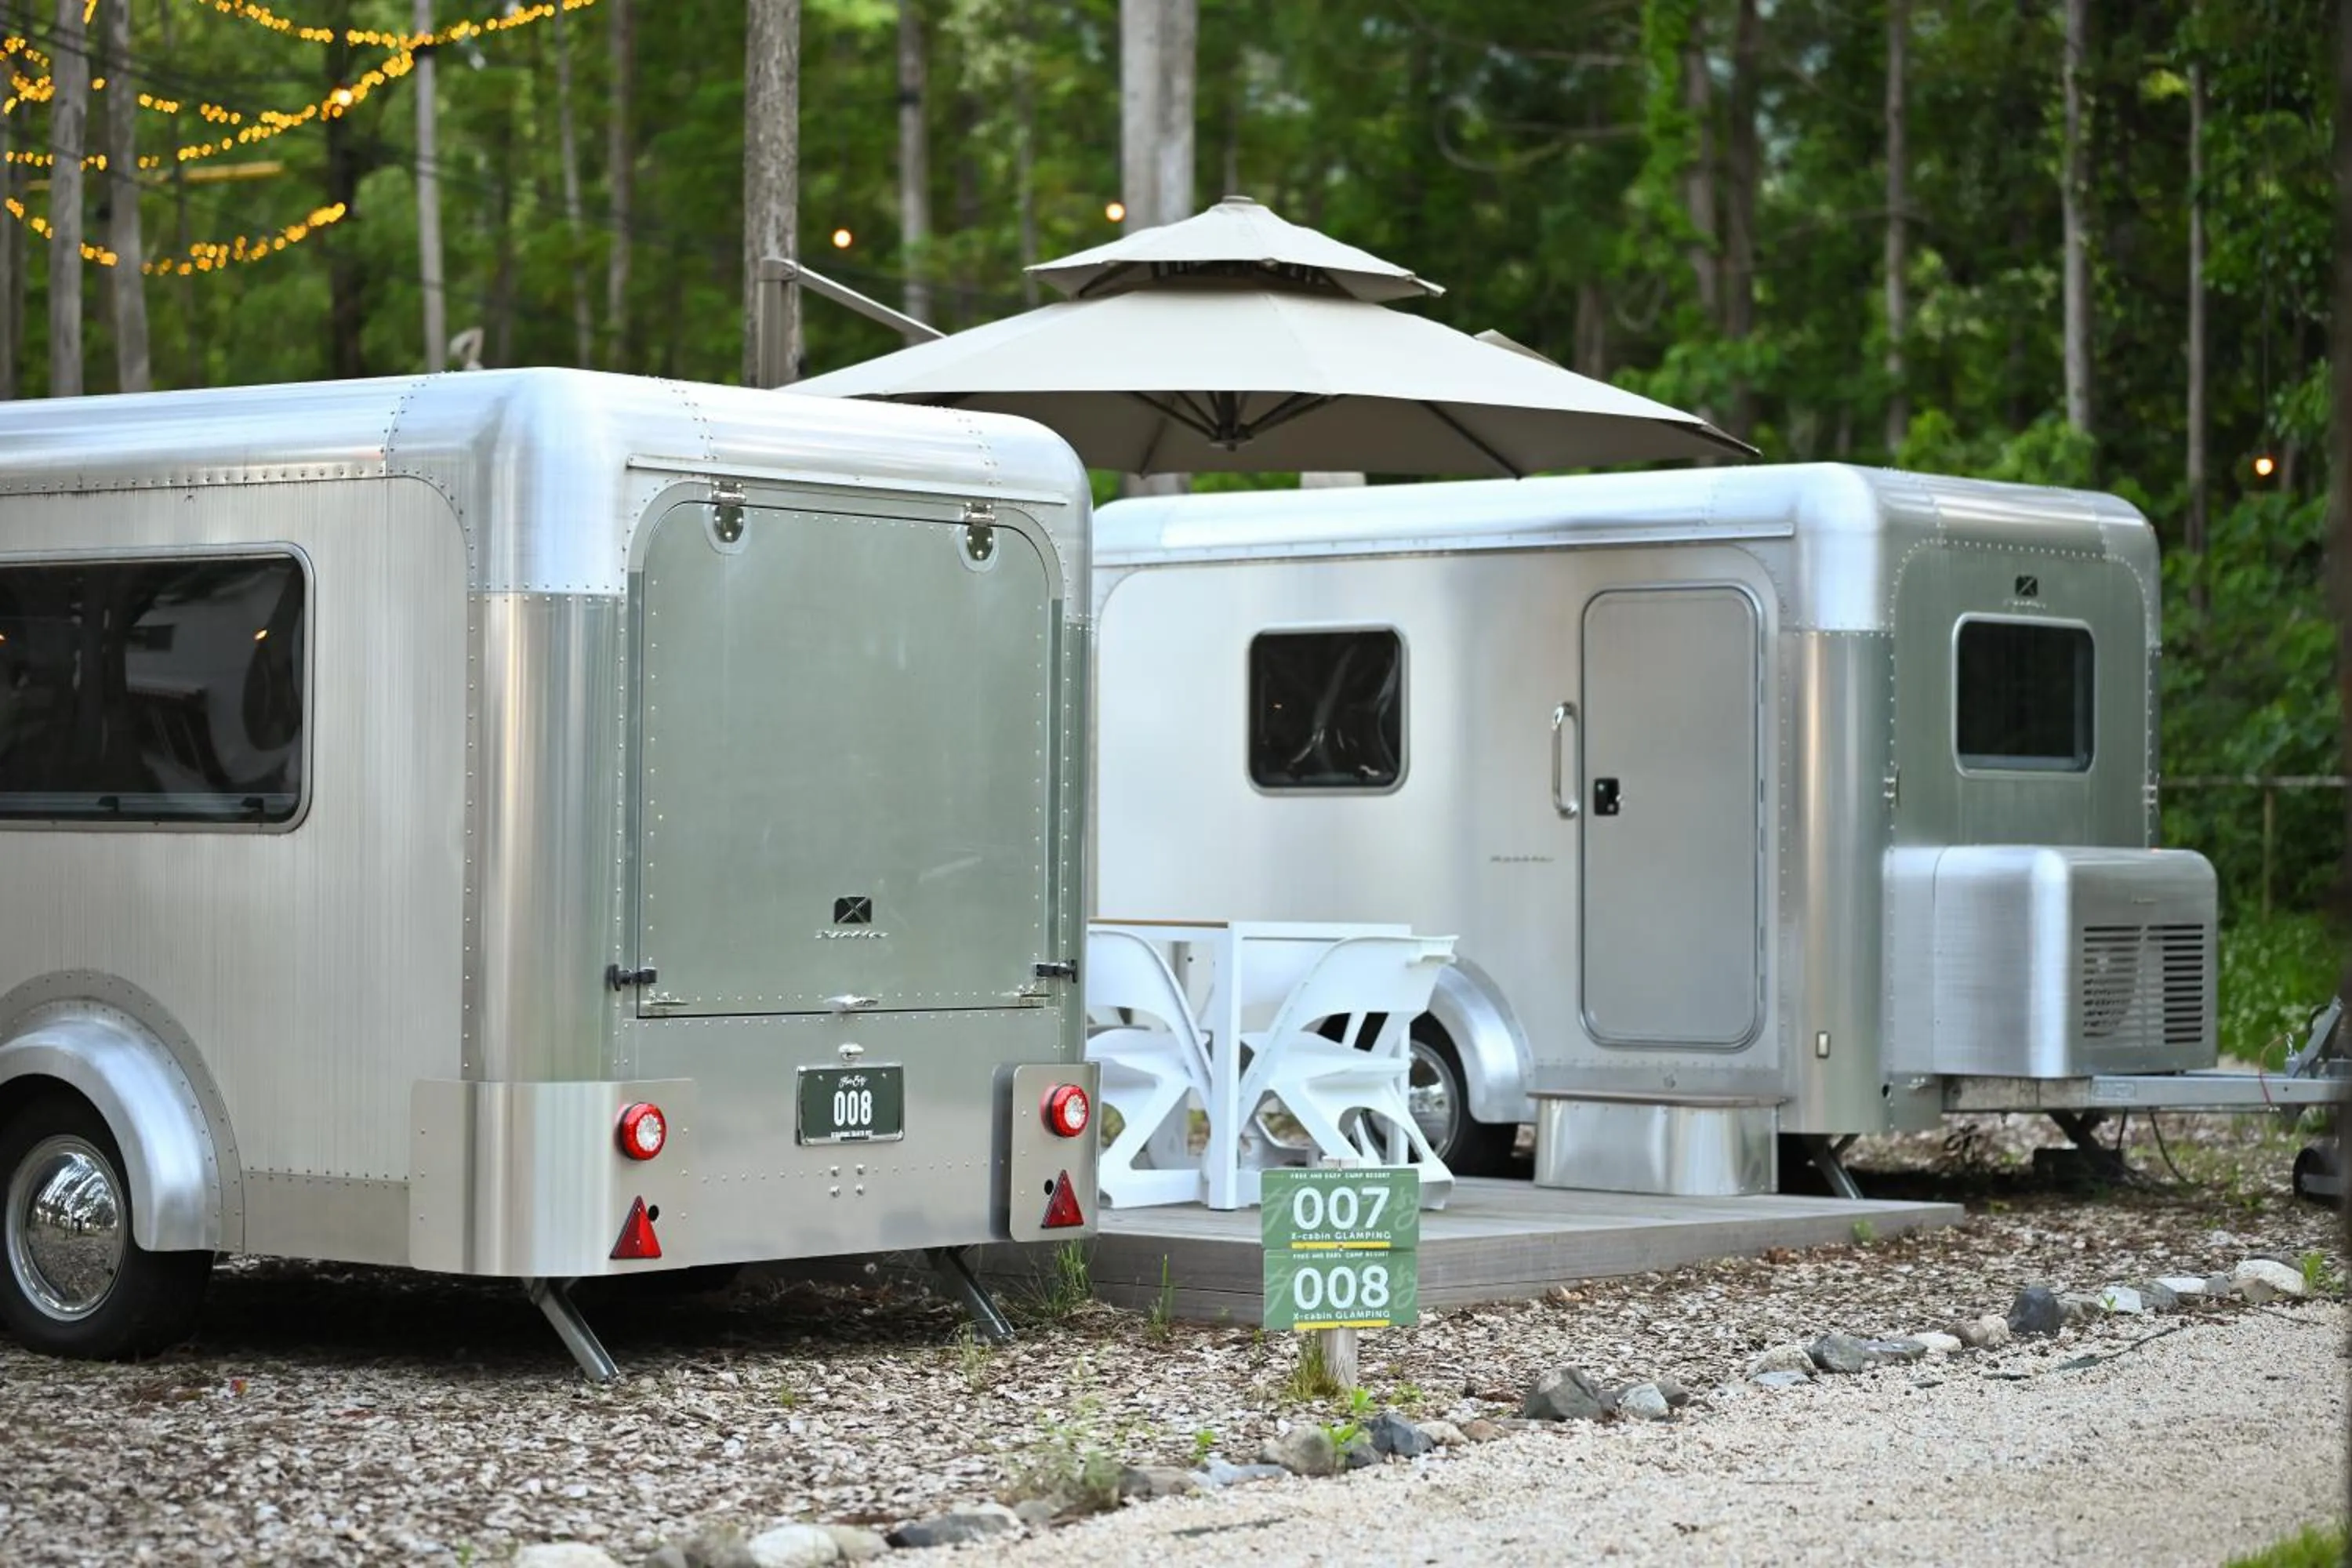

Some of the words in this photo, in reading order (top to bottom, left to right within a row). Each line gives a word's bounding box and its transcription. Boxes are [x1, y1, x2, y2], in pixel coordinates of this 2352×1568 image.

[833, 1090, 873, 1127] 008
[1294, 1186, 1391, 1230] 007
[1335, 1231, 1392, 1240] GLAMPING
[1294, 1265, 1390, 1311] 008
[1335, 1310, 1391, 1319] GLAMPING
